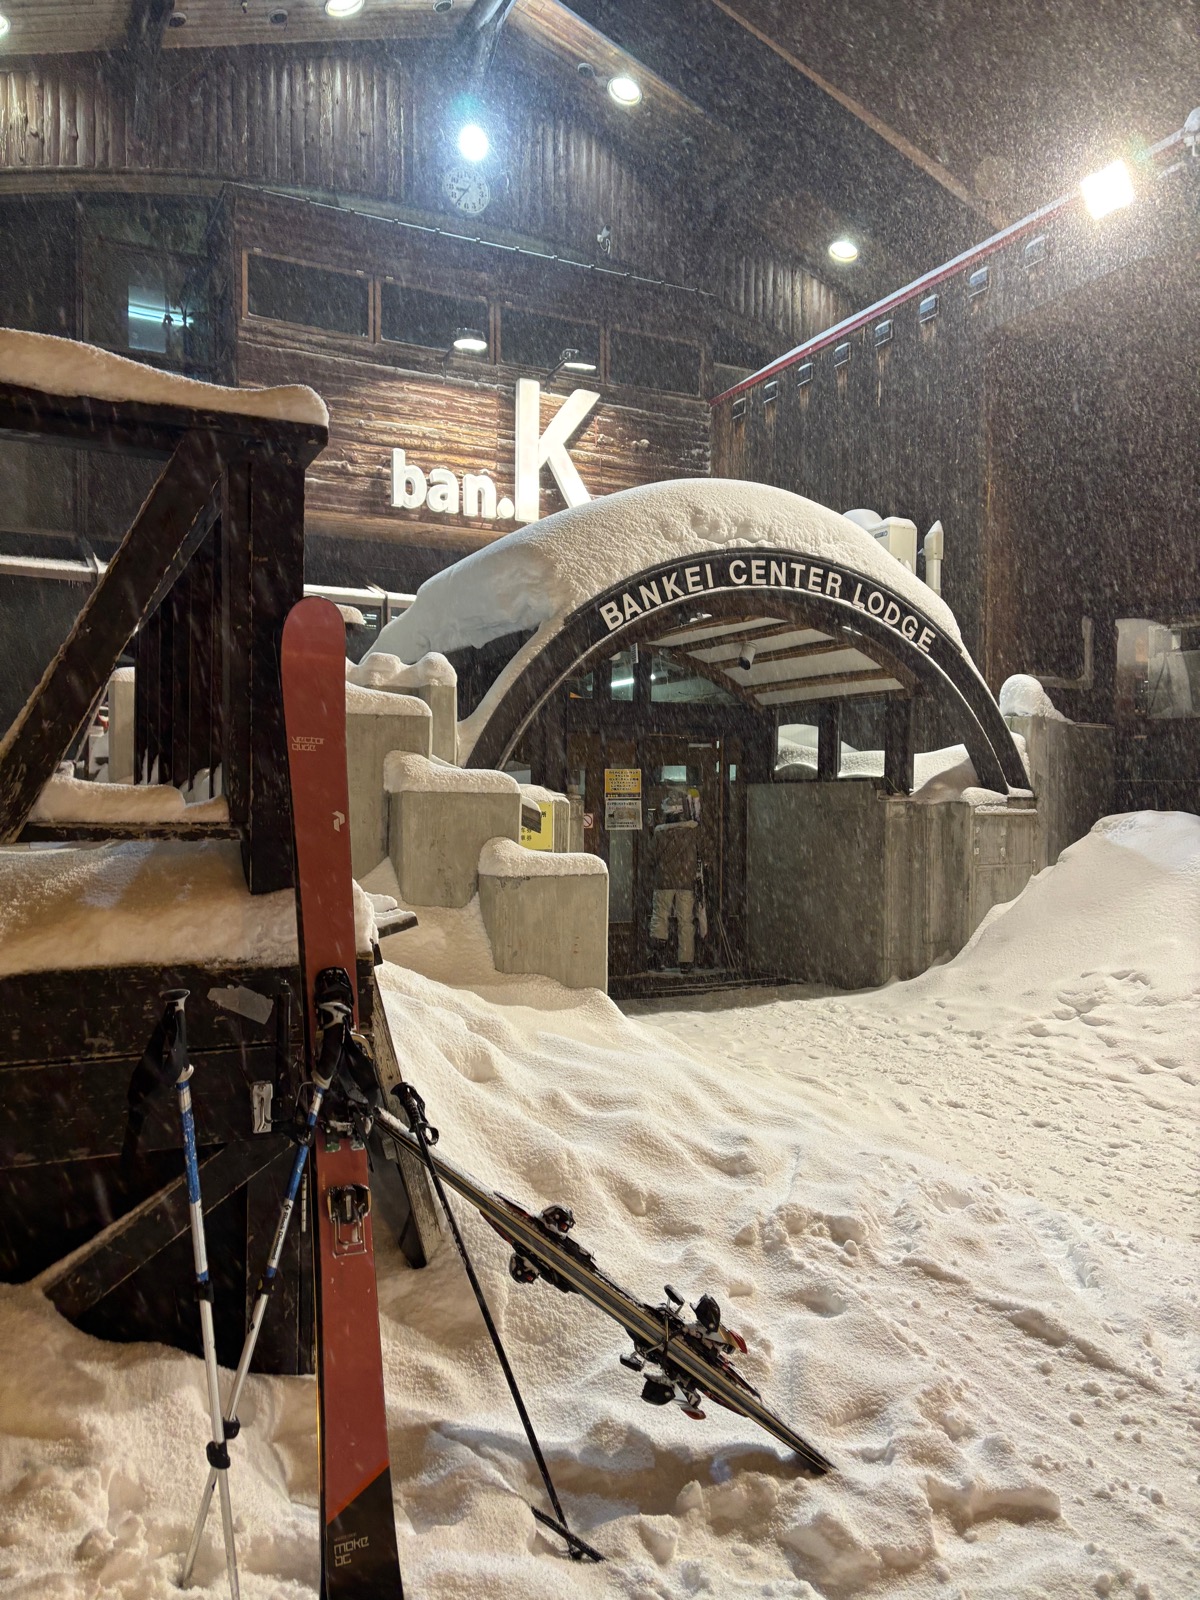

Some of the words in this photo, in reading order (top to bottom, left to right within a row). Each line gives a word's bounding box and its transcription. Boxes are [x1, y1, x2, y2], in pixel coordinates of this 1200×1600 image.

[599, 563, 714, 631] BANKEI
[729, 559, 843, 598] CENTER
[852, 583, 936, 652] LODGE
